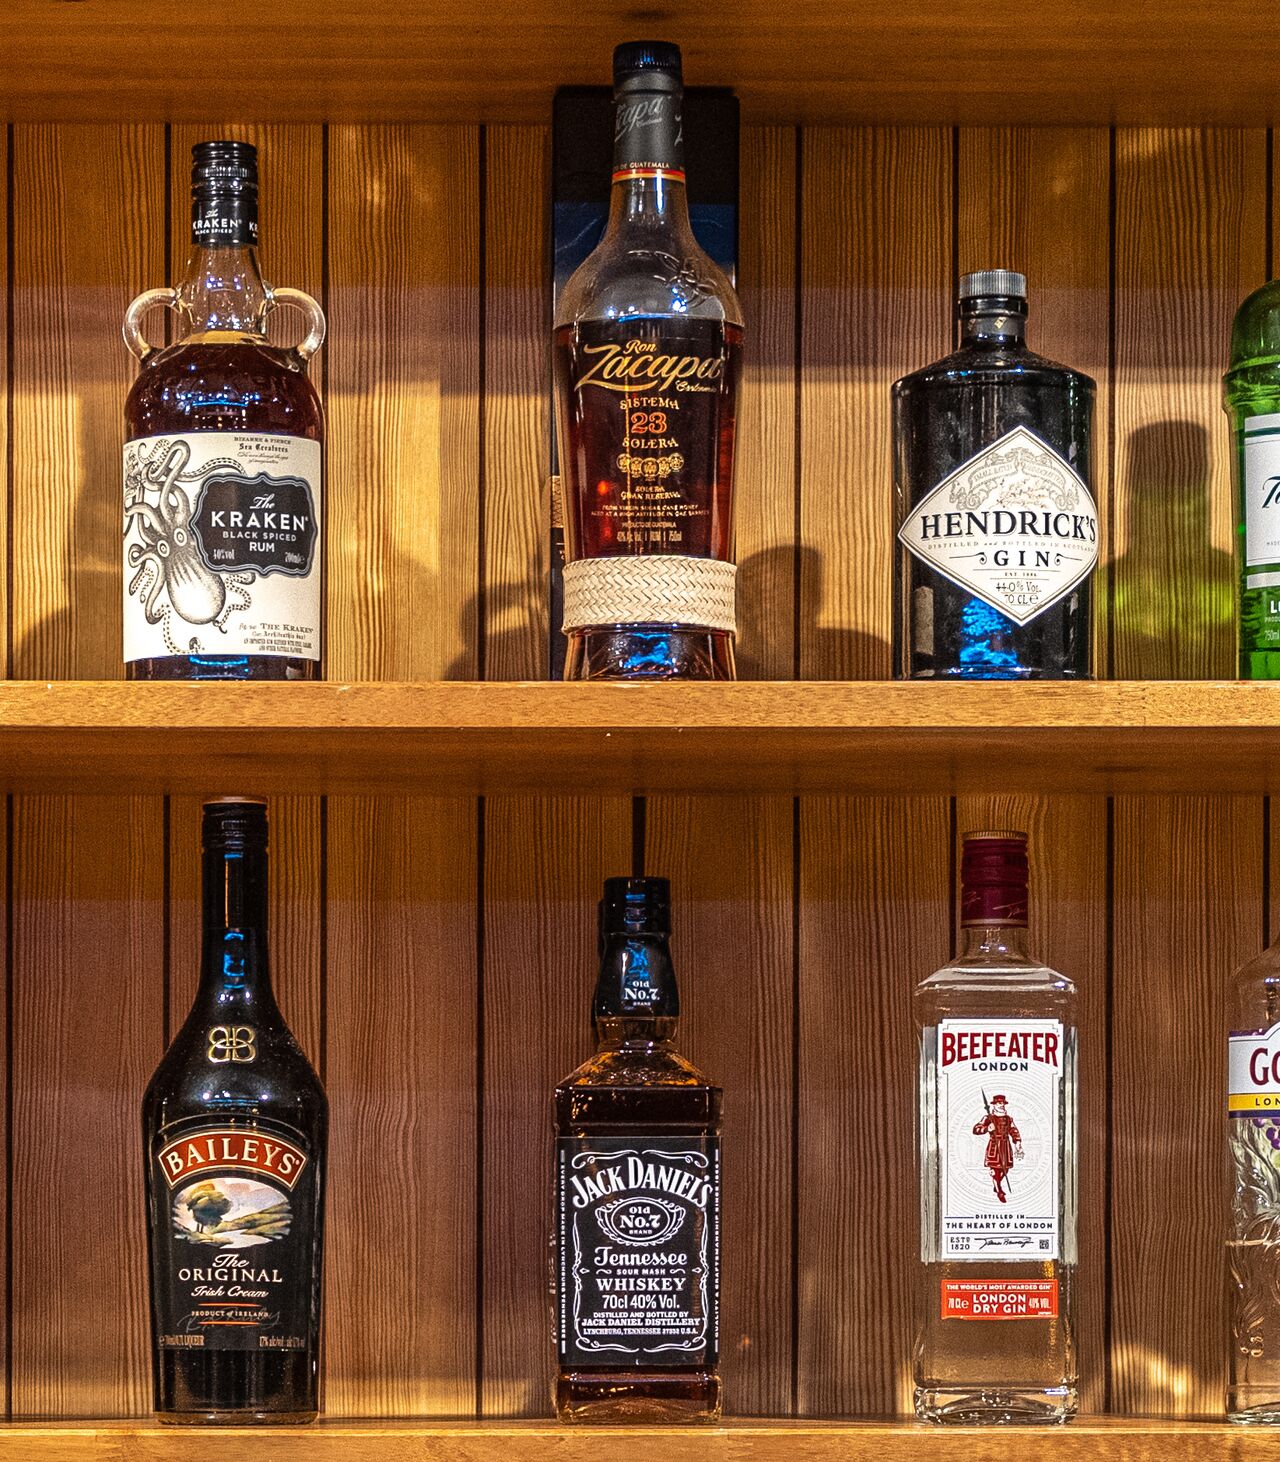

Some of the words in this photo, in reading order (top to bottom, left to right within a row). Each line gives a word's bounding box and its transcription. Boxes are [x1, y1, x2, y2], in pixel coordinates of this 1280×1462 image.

[625, 340, 658, 355] Ron
[574, 343, 722, 392] Zacapa
[630, 412, 667, 434] 23
[249, 494, 275, 509] The
[211, 511, 308, 531] KRAKEN
[920, 511, 1095, 543] HENDRICK'S
[223, 531, 258, 539] BLACK
[263, 531, 297, 542] SPICED
[249, 542, 275, 552] RUM
[993, 550, 1051, 567] GIN
[942, 1032, 1058, 1067] BEEFEATER
[971, 1062, 1028, 1072] LONDON
[166, 1137, 292, 1176] BAILEYS
[570, 1165, 627, 1208] JACK
[627, 1156, 714, 1208] DANIEL'S
[619, 1215, 661, 1229] No.7
[212, 1254, 250, 1268] The
[594, 1246, 687, 1266] Tennessee
[178, 1268, 283, 1283] ORIGINAL
[191, 1286, 225, 1297] Irish
[227, 1285, 269, 1298] Cream
[596, 1278, 686, 1291] WHISKEY
[973, 1293, 1026, 1304] LONDON
[973, 1304, 1002, 1314] DRY
[1005, 1304, 1026, 1314] GIN
